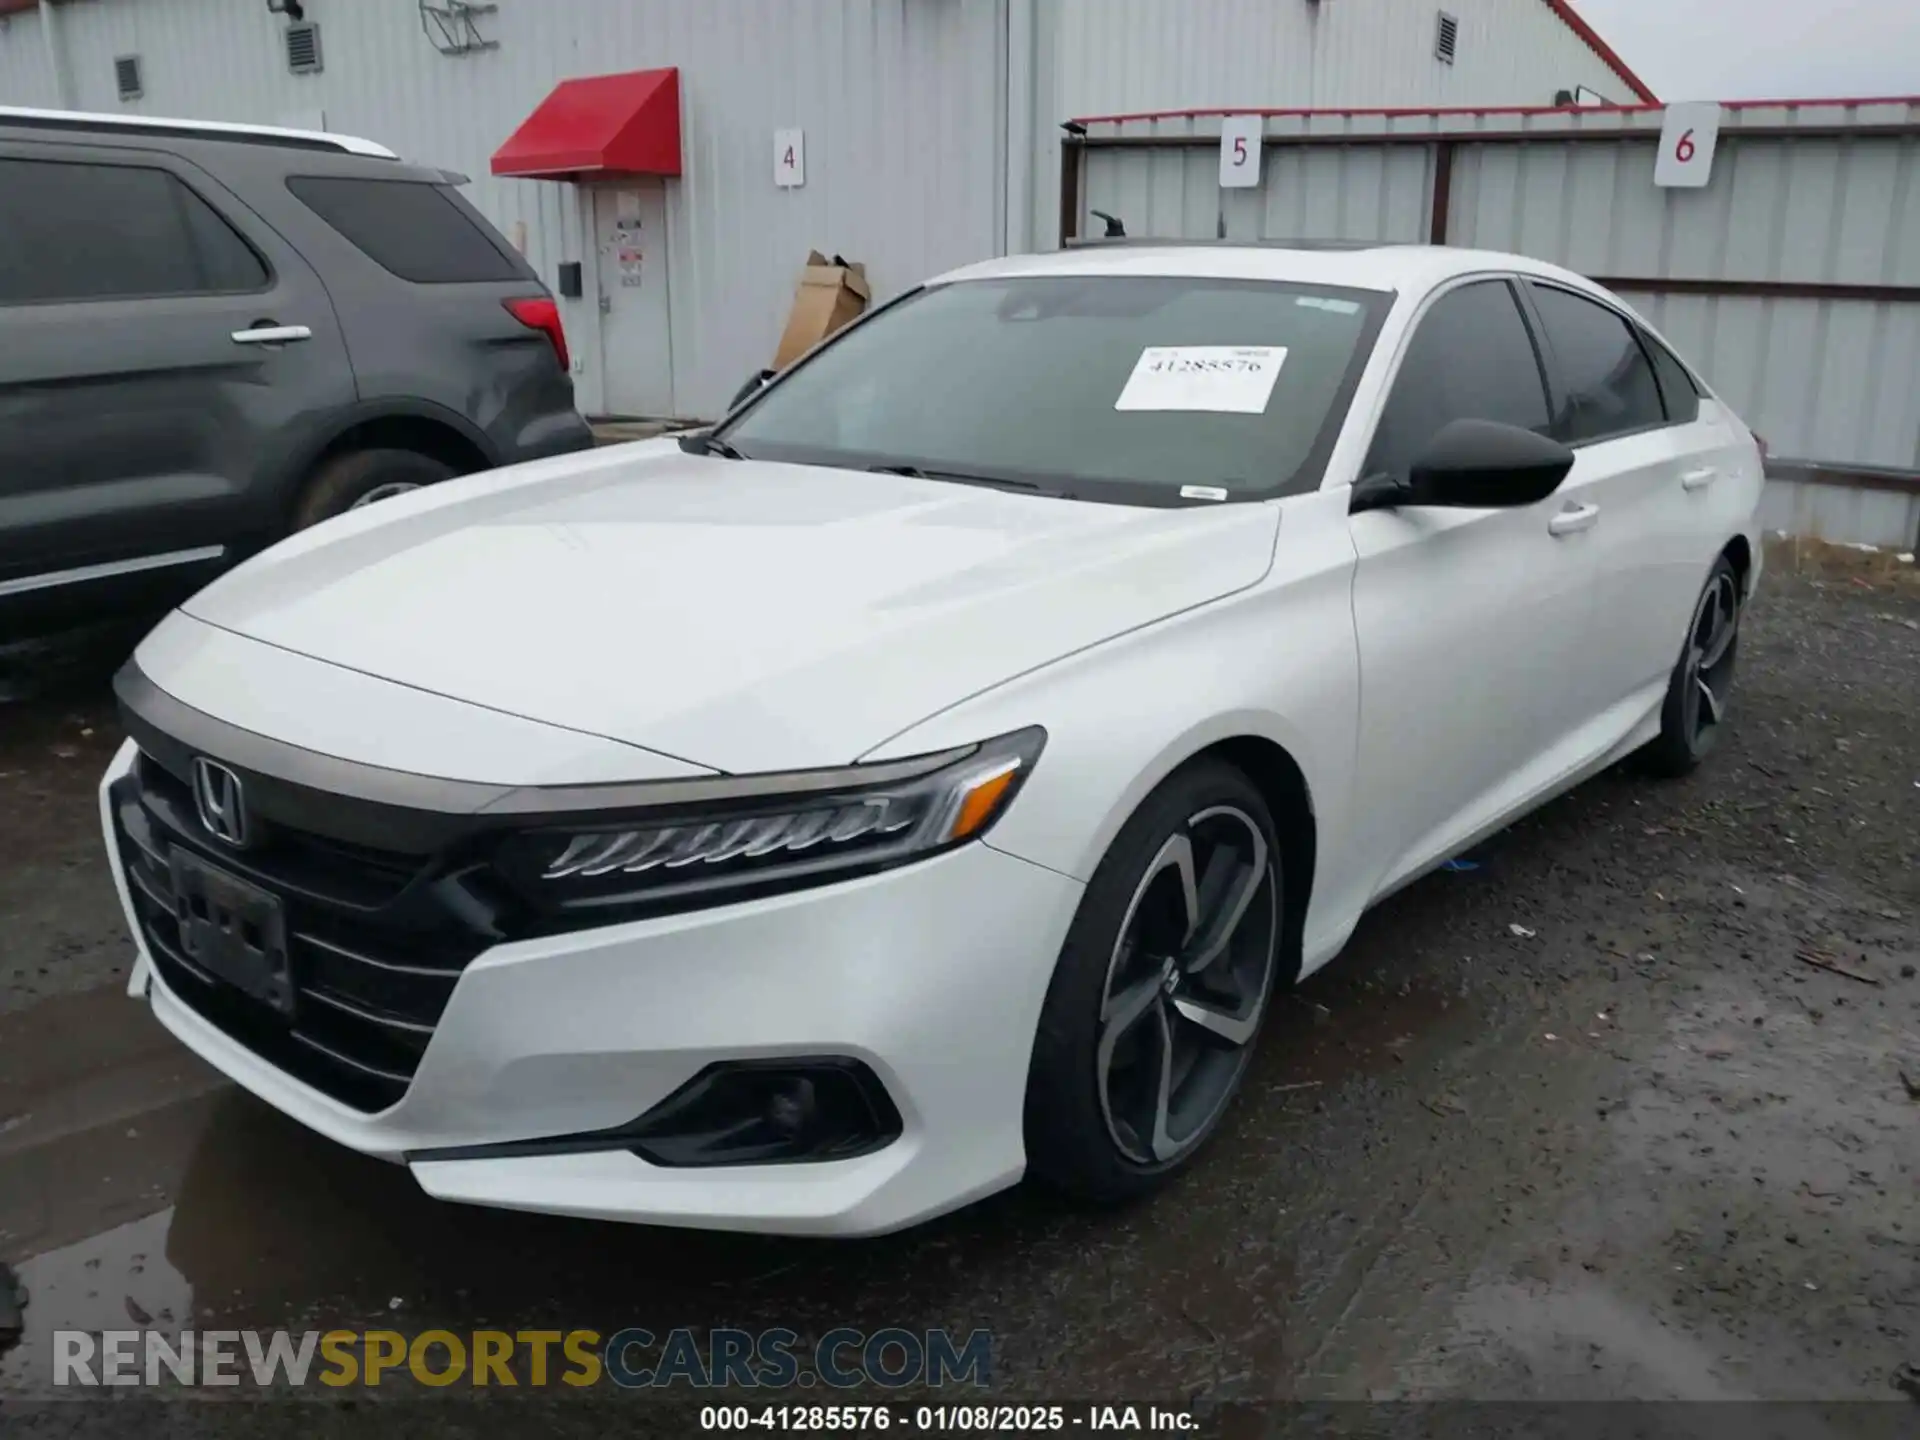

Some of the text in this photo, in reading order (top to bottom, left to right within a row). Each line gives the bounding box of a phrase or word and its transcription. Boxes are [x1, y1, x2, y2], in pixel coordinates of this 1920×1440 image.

[784, 144, 794, 169] 4
[1233, 137, 1247, 166] 5
[1676, 128, 1694, 162] 6
